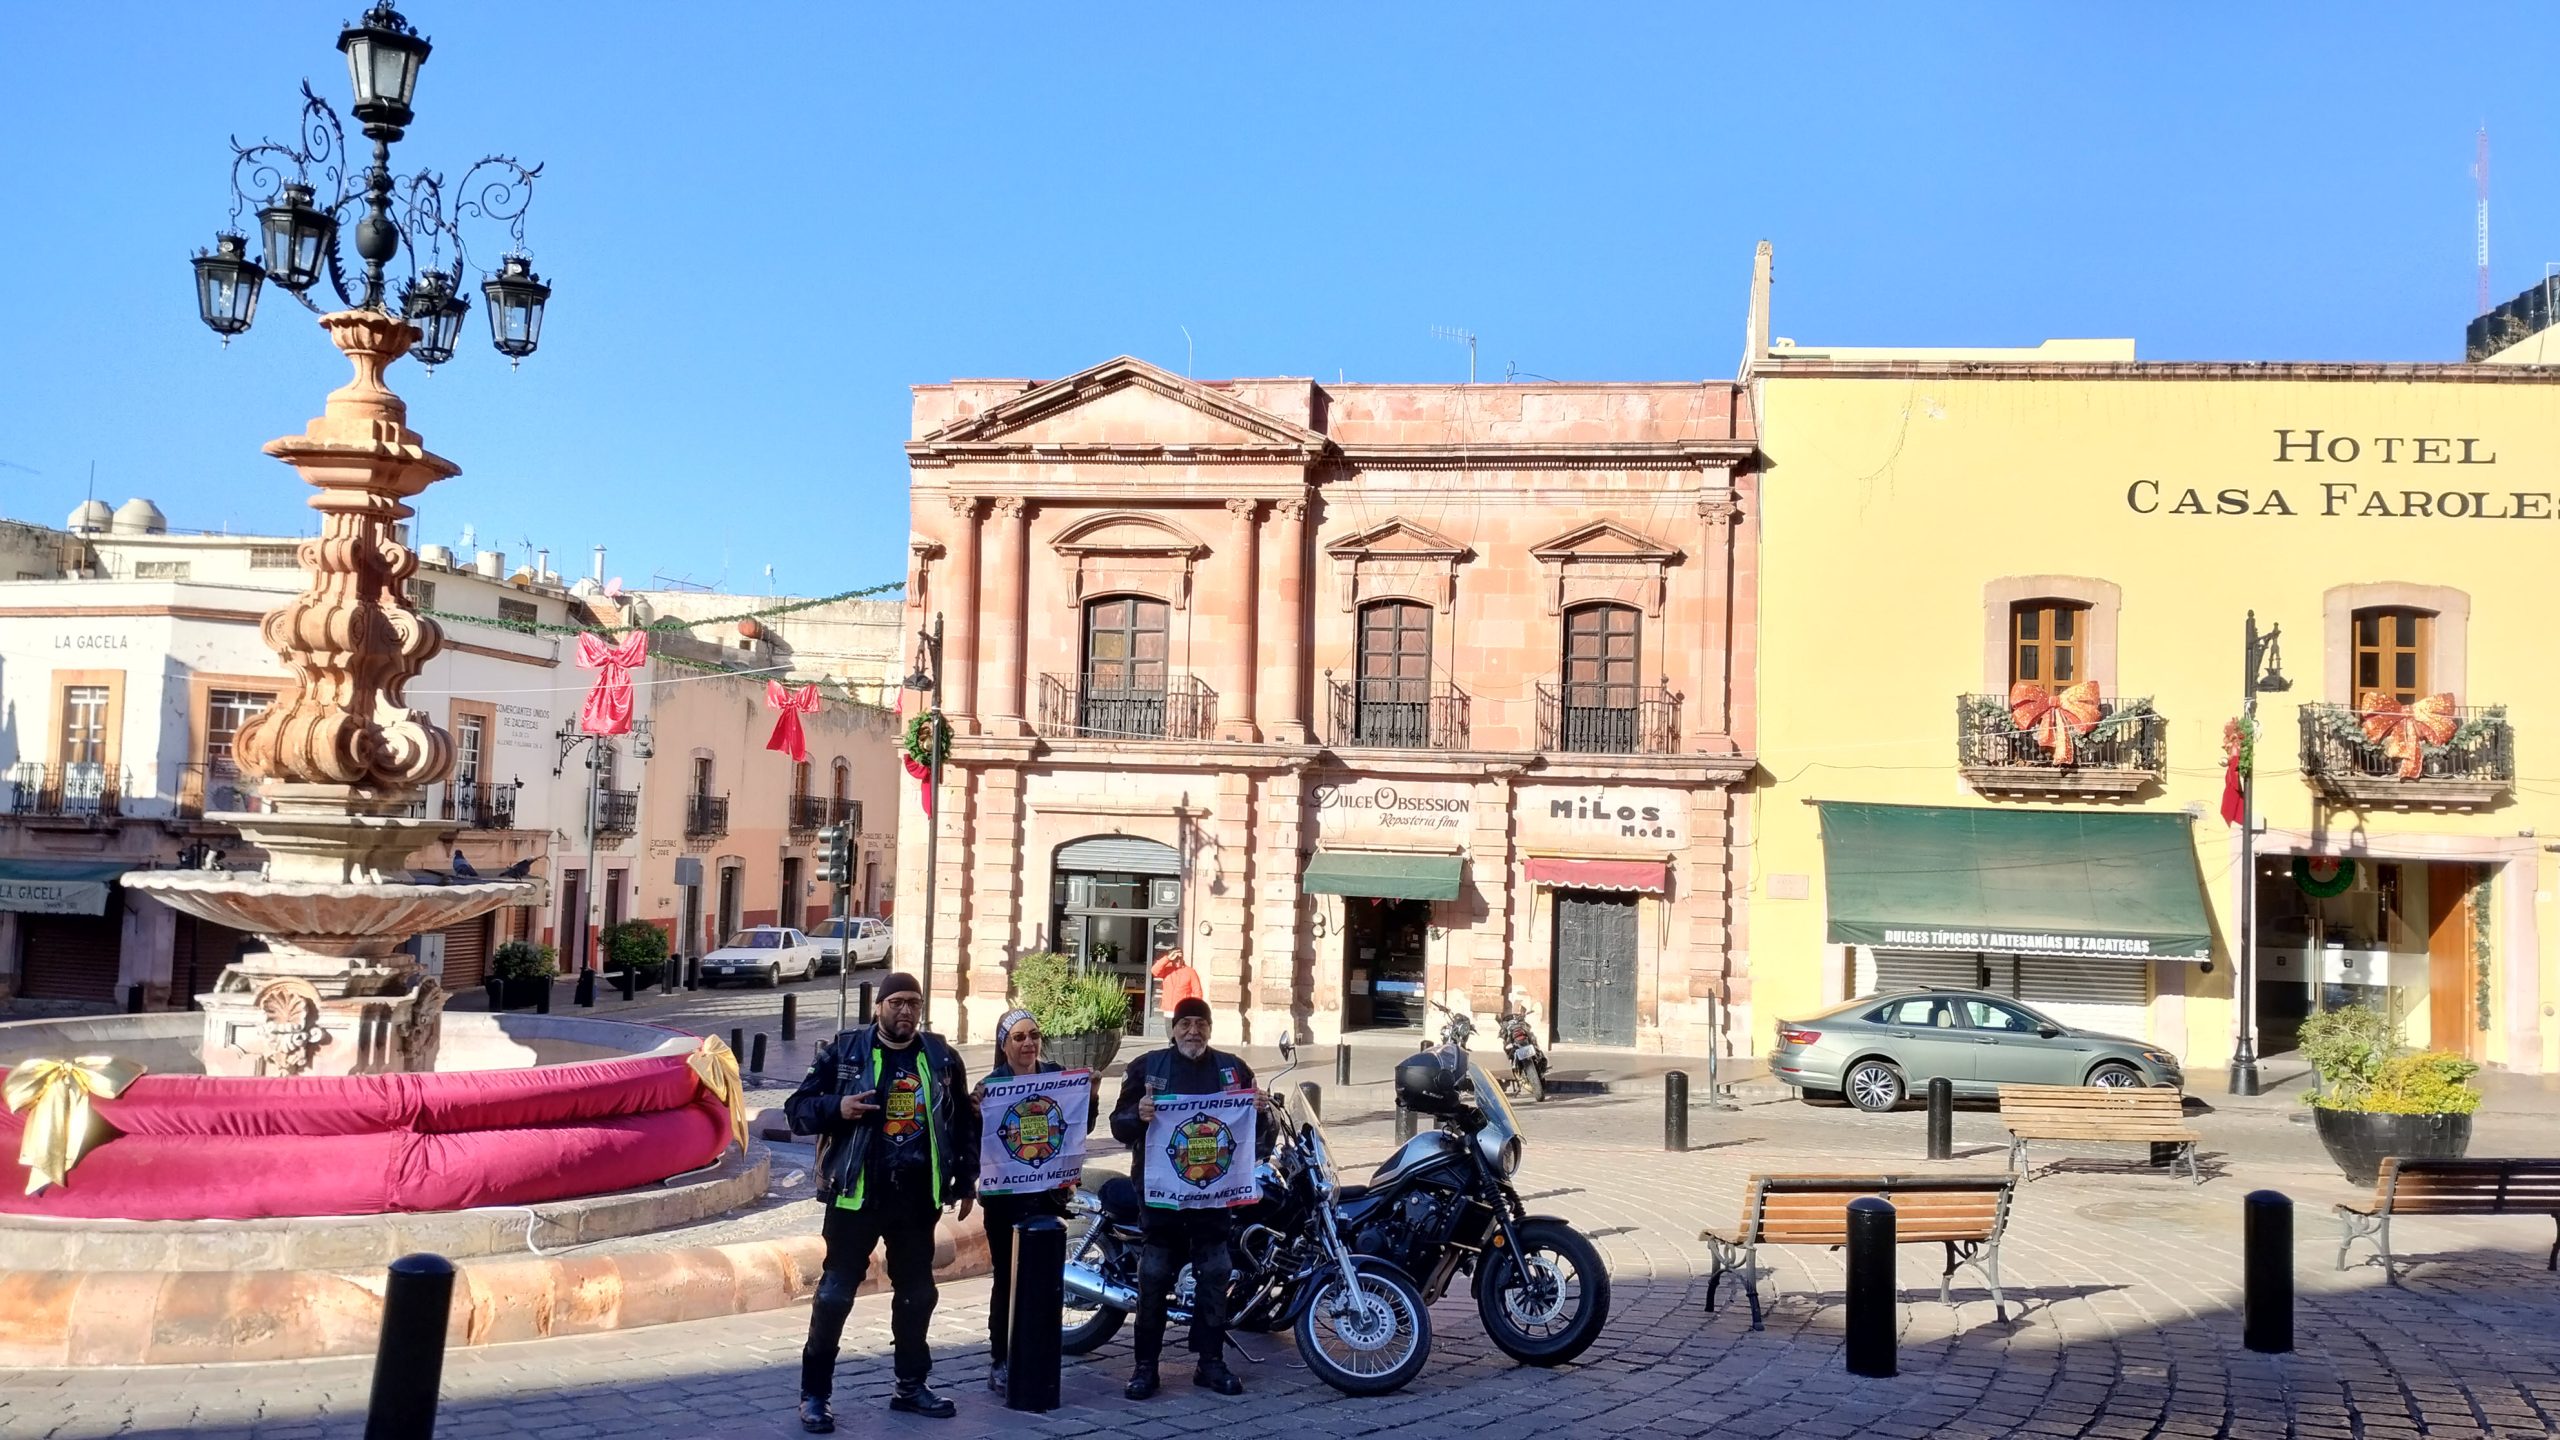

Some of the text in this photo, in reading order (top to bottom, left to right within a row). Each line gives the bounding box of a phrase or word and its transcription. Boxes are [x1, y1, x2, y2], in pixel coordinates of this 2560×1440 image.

[2127, 479, 2560, 520] CASA FAROLE
[55, 635, 128, 649] LA GACELA
[495, 703, 550, 720] COMERCIANTES UNIDOS
[511, 717, 539, 730] ZACATECAS
[1309, 783, 1470, 813] DULCE OBSESSION
[1436, 815, 1460, 831] fina
[1621, 825, 1676, 838] Moda
[0, 885, 63, 900] LA GACELA
[1885, 929, 2151, 954] DULCES TÍPICOS Y ARTESANÍAS DE ZACATECAS
[983, 1076, 1090, 1098] MOTOTURISMO
[983, 1167, 1080, 1186] EN ACCIÓN MÉXICO
[1149, 1186, 1252, 1201] EN ACCIÓN MÉXICO
